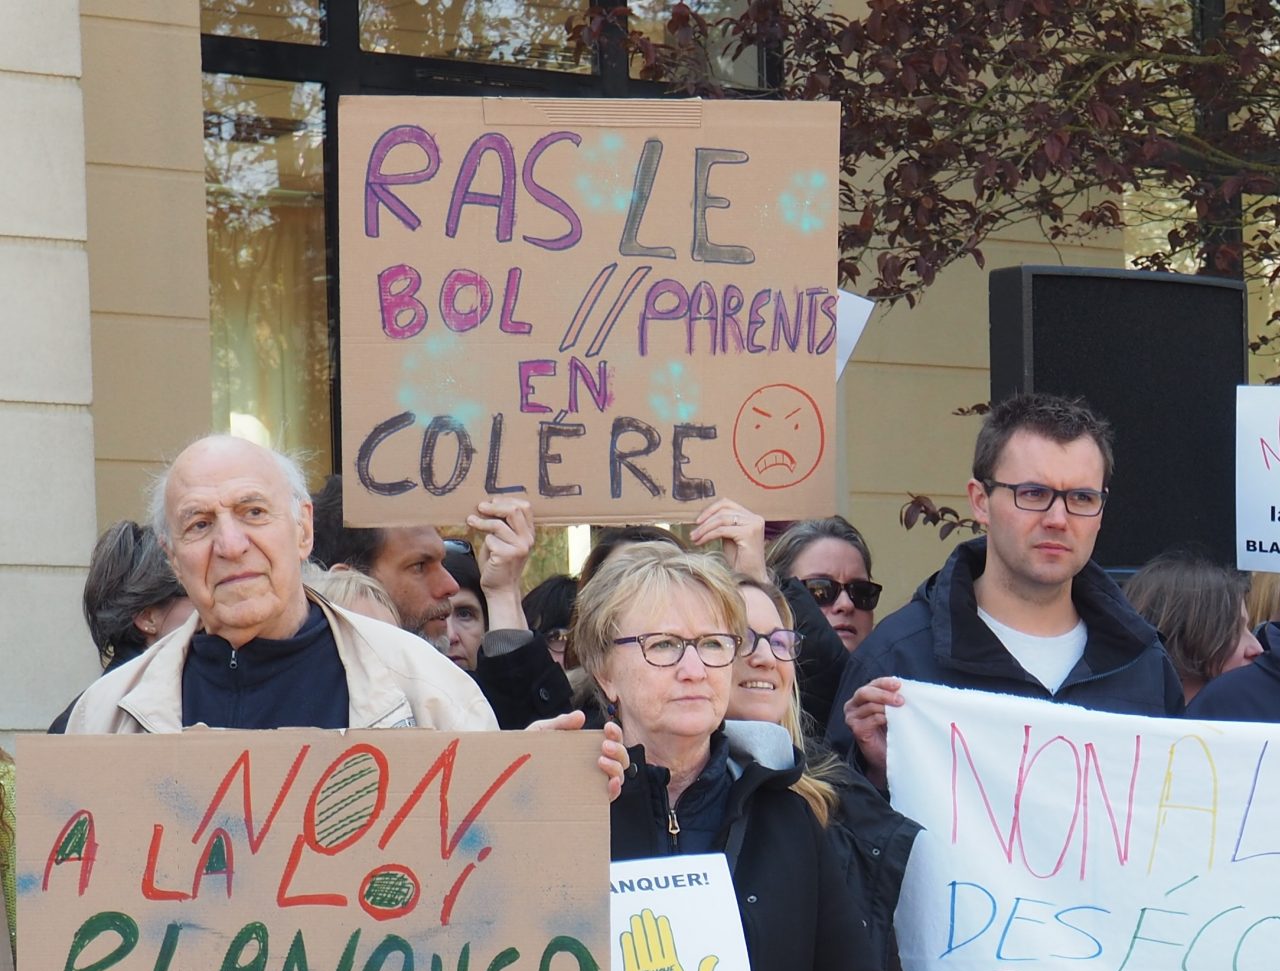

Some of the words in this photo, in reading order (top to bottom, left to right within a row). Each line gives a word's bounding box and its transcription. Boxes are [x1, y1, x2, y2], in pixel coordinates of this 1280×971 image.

[364, 124, 582, 251] RAS
[619, 136, 755, 265] LE
[377, 263, 533, 340] BOL
[518, 356, 612, 414] EN
[193, 739, 531, 857] NON
[948, 722, 1141, 881] NON
[42, 809, 99, 896] A
[142, 823, 235, 901] LA
[940, 881, 1110, 962] DES
